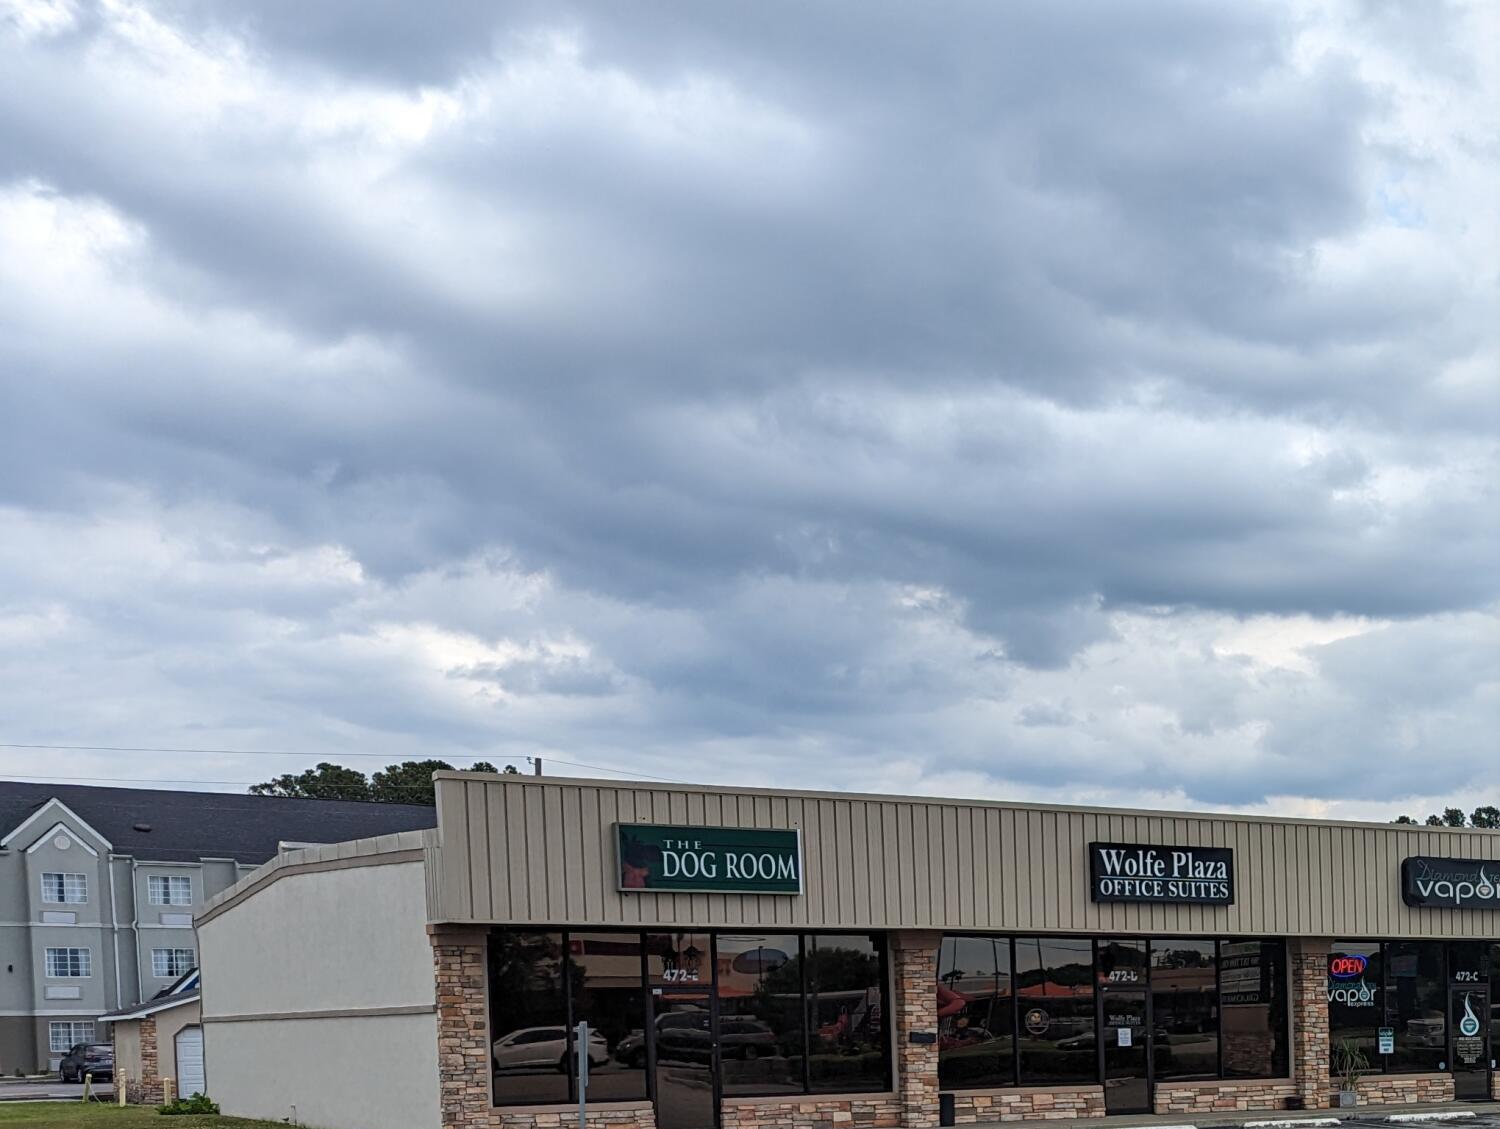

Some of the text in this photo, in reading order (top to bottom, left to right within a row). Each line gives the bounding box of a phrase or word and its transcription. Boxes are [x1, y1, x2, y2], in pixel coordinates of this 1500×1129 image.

[663, 839, 703, 850] THE
[661, 850, 797, 880] DOG ROOM
[1098, 848, 1228, 879] Wolfe Plaza
[1415, 859, 1480, 882] Diamond
[1099, 879, 1229, 899] OFFICE SUITES
[1331, 958, 1364, 974] OPEN
[1455, 970, 1479, 981] 472-C
[1328, 985, 1377, 1007] vapor
